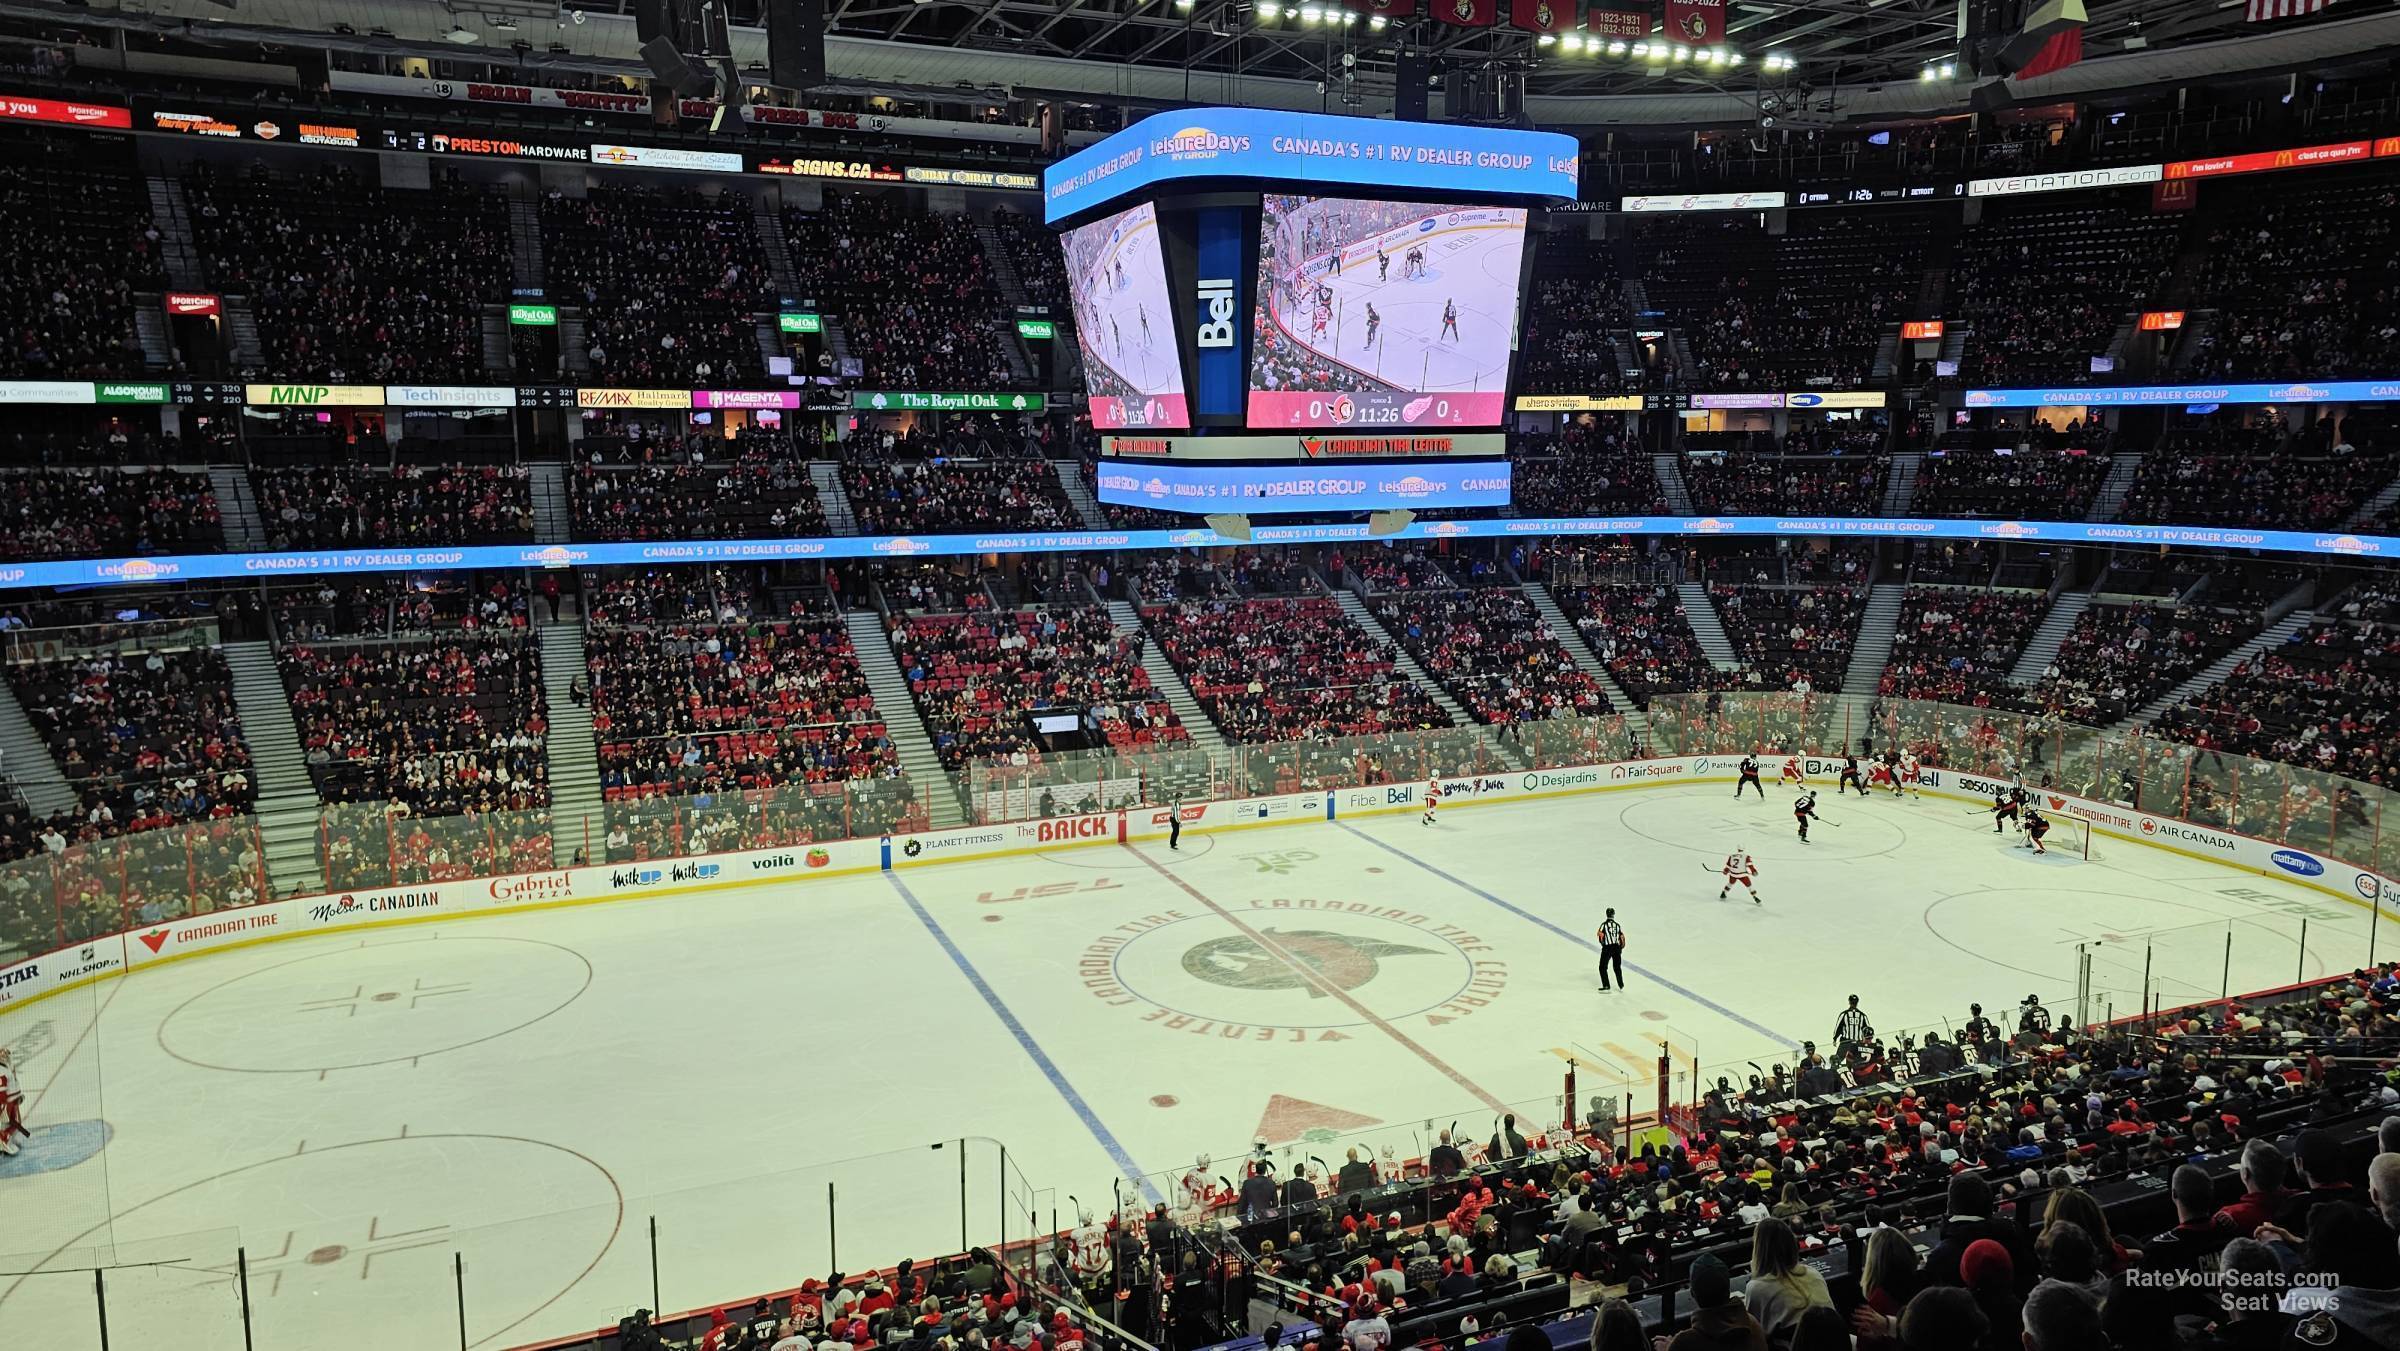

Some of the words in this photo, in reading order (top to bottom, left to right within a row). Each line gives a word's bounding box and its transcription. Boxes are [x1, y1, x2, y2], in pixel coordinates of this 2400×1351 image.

[1600, 12, 1640, 26] 1923-1931
[1600, 23, 1640, 37] 1932-1933
[435, 82, 450, 94] 18
[9, 103, 37, 115] you
[67, 106, 109, 118] SPORTCHEK
[871, 117, 884, 129] 18
[389, 136, 397, 147] 4
[417, 138, 426, 149] 2
[1151, 132, 1250, 158] LeisureDays
[1171, 154, 1183, 163] RV
[1184, 151, 1218, 161] GROUP
[1272, 136, 1361, 160] CANADA'S
[1365, 144, 1384, 160] #1
[1391, 145, 1413, 163] RV
[1417, 148, 1473, 166] DEALER
[1477, 152, 1533, 169] GROUP
[2298, 151, 2318, 160] c'est
[2319, 150, 2330, 159] ça
[2330, 149, 2346, 159] que
[792, 160, 872, 178] SIGNS.CA
[1052, 176, 1080, 199] CANADA'S
[1098, 159, 1118, 181] DEALER
[1119, 147, 1143, 173] GROUP
[1974, 170, 2157, 194] LIVENATION.com
[1848, 190, 1872, 200] 11:26
[1909, 188, 1933, 196] DETROIT
[171, 296, 215, 306] SPORTCHEK
[1198, 279, 1233, 347] Bell
[10, 388, 79, 397] Communities
[104, 385, 163, 397] ALGONQUIN
[175, 384, 192, 392] 319
[222, 384, 240, 392] 320
[270, 386, 329, 404] MNP
[520, 388, 536, 396] 320
[2044, 391, 2101, 402] CANADA'S
[2104, 391, 2118, 400] #1
[2123, 390, 2137, 400] RV
[2141, 388, 2180, 400] DEALER
[2185, 388, 2229, 400] GROUP
[2270, 388, 2329, 399] LeisureDays
[177, 395, 193, 403] 219
[223, 396, 241, 404] 220
[402, 388, 501, 404] TechInsights
[580, 391, 633, 406] RE/MAX
[637, 391, 688, 400] Hallmark
[724, 392, 783, 402] MAGENTA
[901, 394, 928, 406] The
[930, 394, 969, 409] Royal
[971, 394, 998, 407] Oak
[1387, 395, 1392, 404] 1
[560, 399, 574, 407] 221
[1128, 411, 1146, 424] 11:26
[1310, 401, 1321, 418] 0
[1359, 408, 1398, 423] 11:26
[1438, 401, 1448, 417] 0
[1325, 439, 1385, 454] CANADIAN
[1387, 439, 1411, 453] TIRE
[1413, 439, 1453, 453] CENTRE
[1174, 484, 1216, 497] CANADA'S
[1222, 484, 1237, 497] #1
[1244, 484, 1262, 497] RV
[1266, 483, 1315, 497] DEALER
[1318, 480, 1367, 495] GROUP
[1379, 481, 1447, 494] LeisureDays
[2088, 527, 2142, 539] CANADA'S
[2147, 530, 2158, 540] #1
[2163, 531, 2179, 541] RV
[2182, 532, 2221, 543] DEALER
[2224, 534, 2264, 545] GROUP
[1290, 548, 1301, 556] 117
[2315, 538, 2381, 552] LeisureDays
[97, 561, 179, 577] LeisureDays
[1629, 764, 1683, 779] FairSquare
[1542, 772, 1598, 787] Desjardins
[1444, 782, 1472, 797] Booster
[1482, 779, 1505, 792] Juice
[1350, 794, 1377, 808] Fibe
[1387, 787, 1413, 804] Bell
[2069, 804, 2110, 824] CANADIAN
[2113, 816, 2132, 829] TIRE
[1017, 825, 1035, 837] The
[1038, 816, 1108, 842] BRICK
[926, 837, 962, 849] PLANET
[965, 833, 1004, 845] FITNESS
[2160, 825, 2179, 838] AIR
[2181, 829, 2236, 851] CANADA
[752, 854, 795, 869] voilà
[490, 872, 572, 900] Gabriel
[516, 889, 573, 901] PIZZA
[309, 903, 364, 922] Molson
[370, 891, 439, 912] CANADIAN
[1250, 898, 1430, 926] CANADIAN
[177, 919, 246, 943] CANADIAN
[248, 913, 279, 930] TIRE
[1431, 923, 1493, 953] TIRE
[1079, 935, 1141, 1006] CANADIAN
[1115, 909, 1188, 934] TIRE
[1441, 960, 1508, 1016] CENTRE
[1139, 1008, 1306, 1043] CENTRE
[1860, 1052, 1872, 1063] 7
[1084, 1242, 1102, 1265] 17
